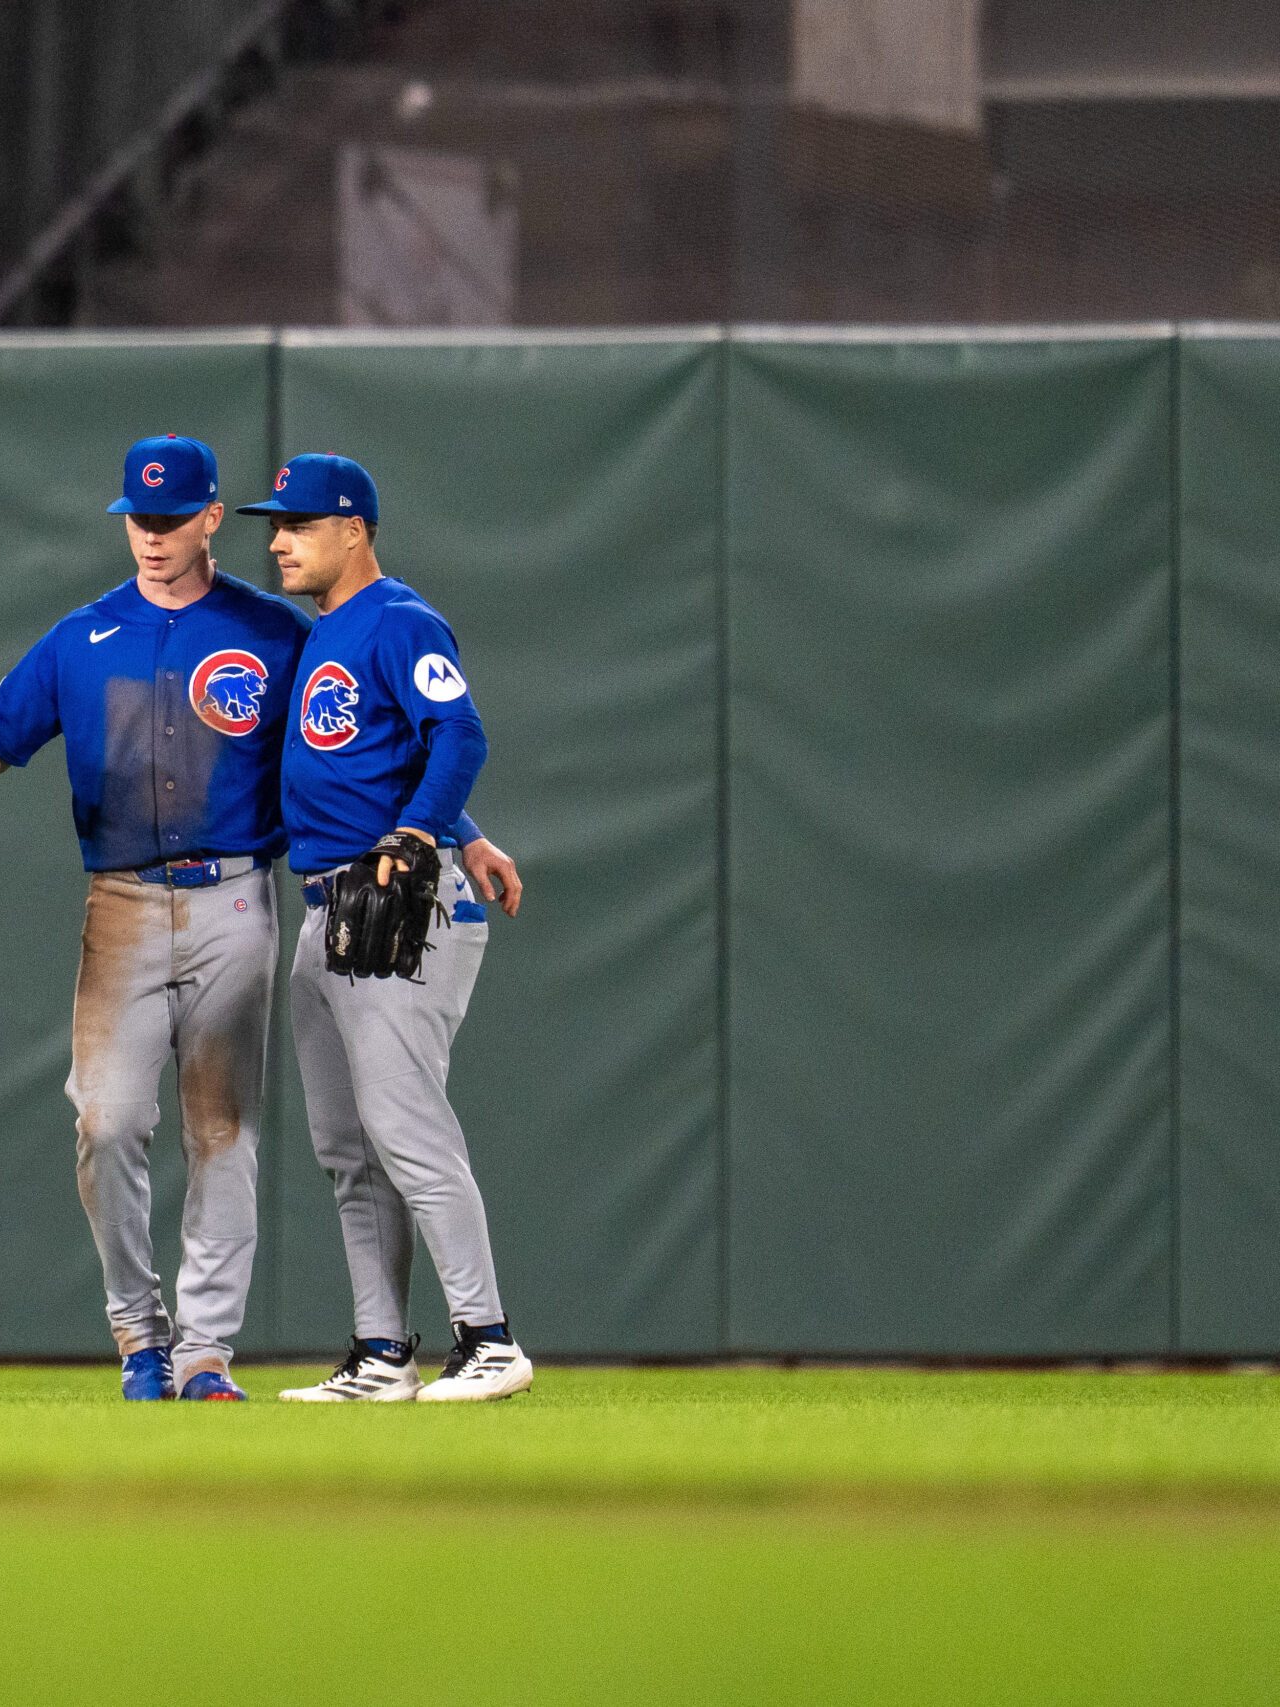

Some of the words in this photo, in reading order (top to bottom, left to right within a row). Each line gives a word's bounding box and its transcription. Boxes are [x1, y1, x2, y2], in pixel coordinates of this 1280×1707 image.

[142, 462, 165, 487] C
[274, 468, 291, 491] C
[210, 863, 217, 877] 4
